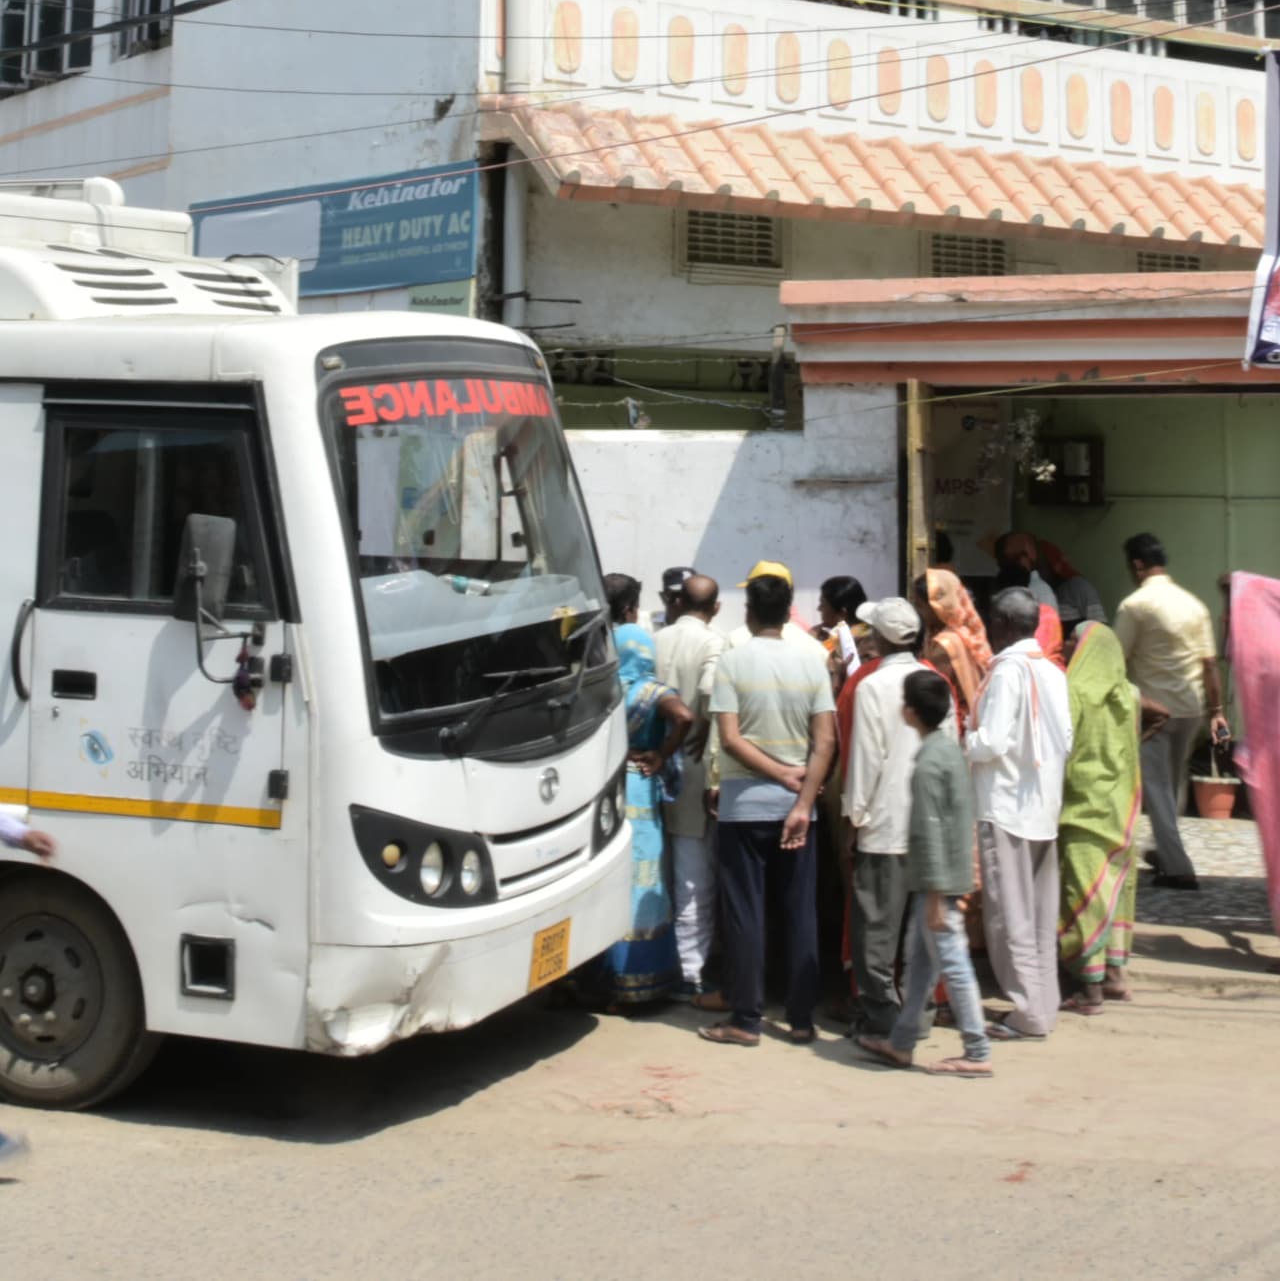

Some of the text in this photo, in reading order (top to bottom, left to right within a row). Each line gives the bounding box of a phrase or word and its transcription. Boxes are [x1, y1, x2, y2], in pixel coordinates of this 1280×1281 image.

[346, 177, 468, 212] Kelvinator
[341, 209, 472, 249] HEAVY DUTY AC
[127, 753, 209, 787] अभियान
